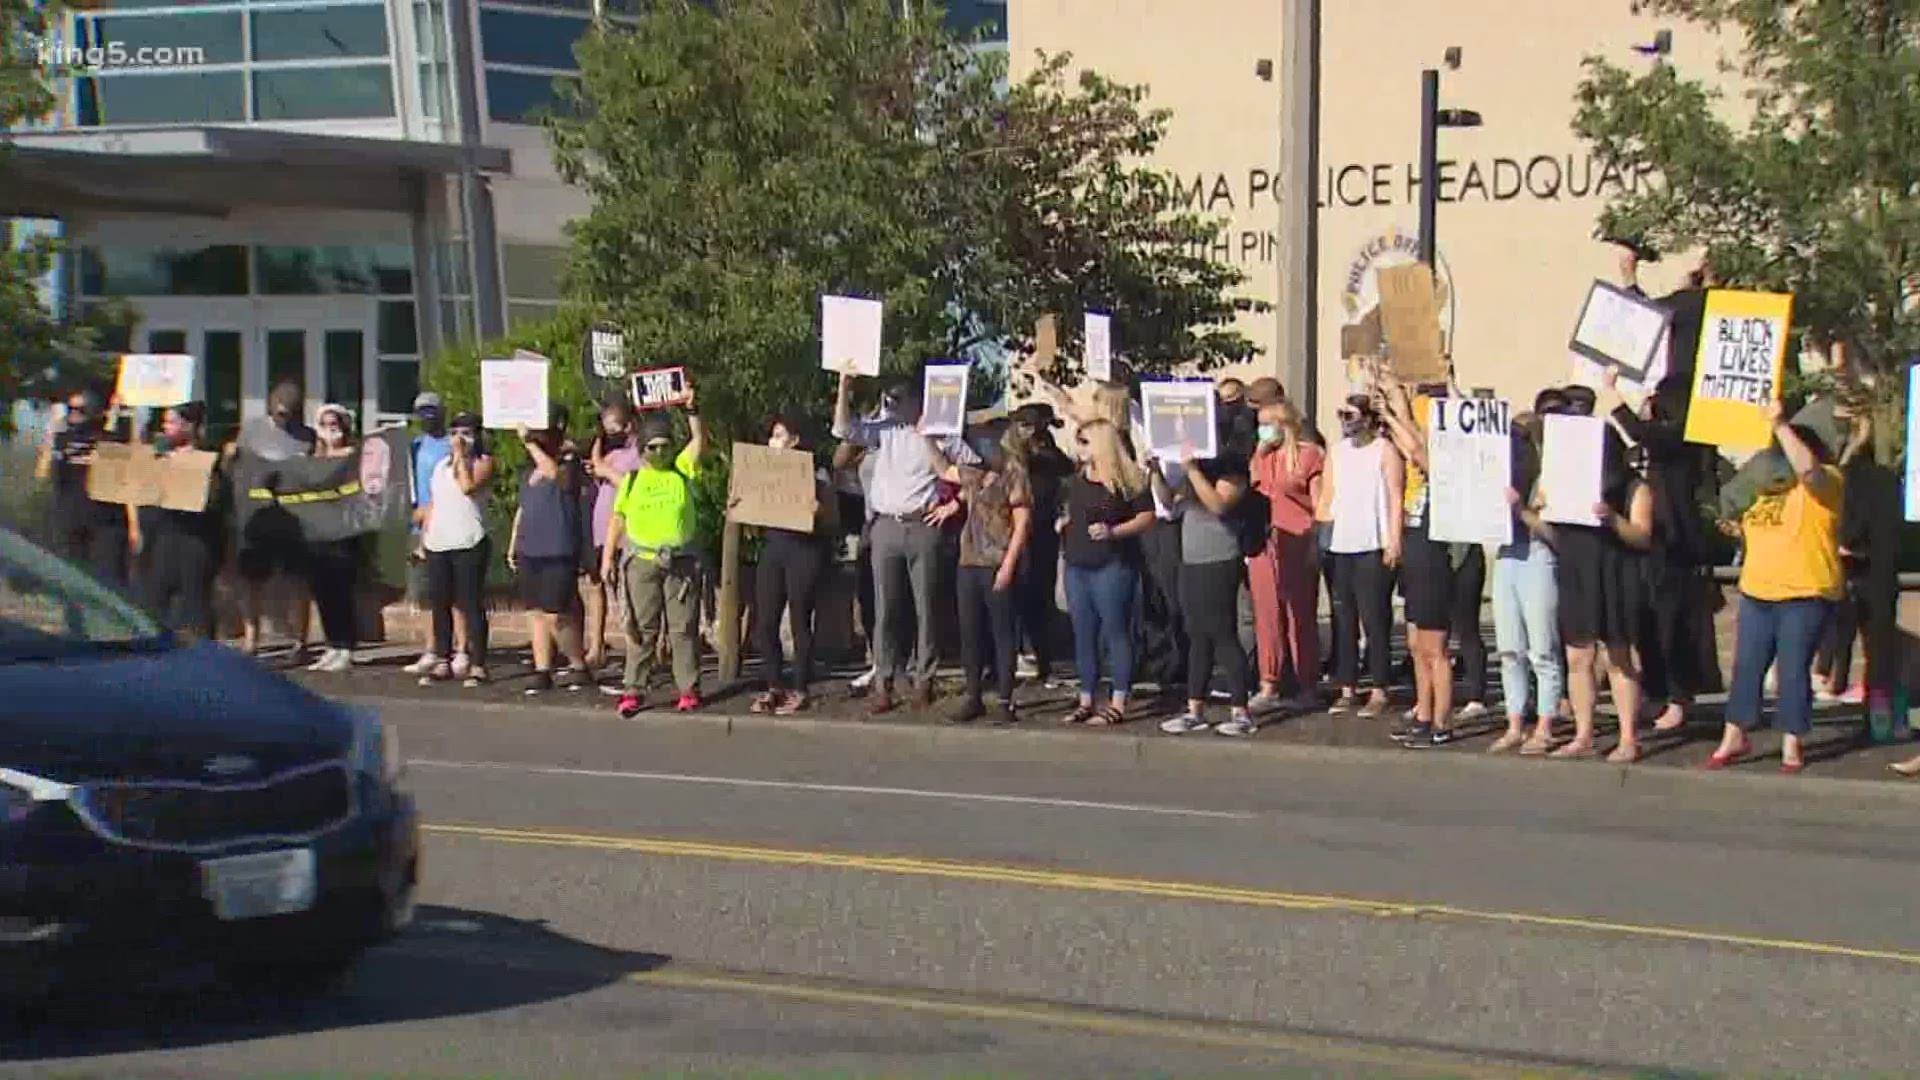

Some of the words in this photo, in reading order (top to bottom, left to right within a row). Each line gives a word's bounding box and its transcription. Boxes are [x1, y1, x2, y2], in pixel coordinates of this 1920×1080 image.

[1720, 345, 1771, 374] LIVES
[1702, 373, 1773, 406] MATTER
[1438, 400, 1447, 431] I
